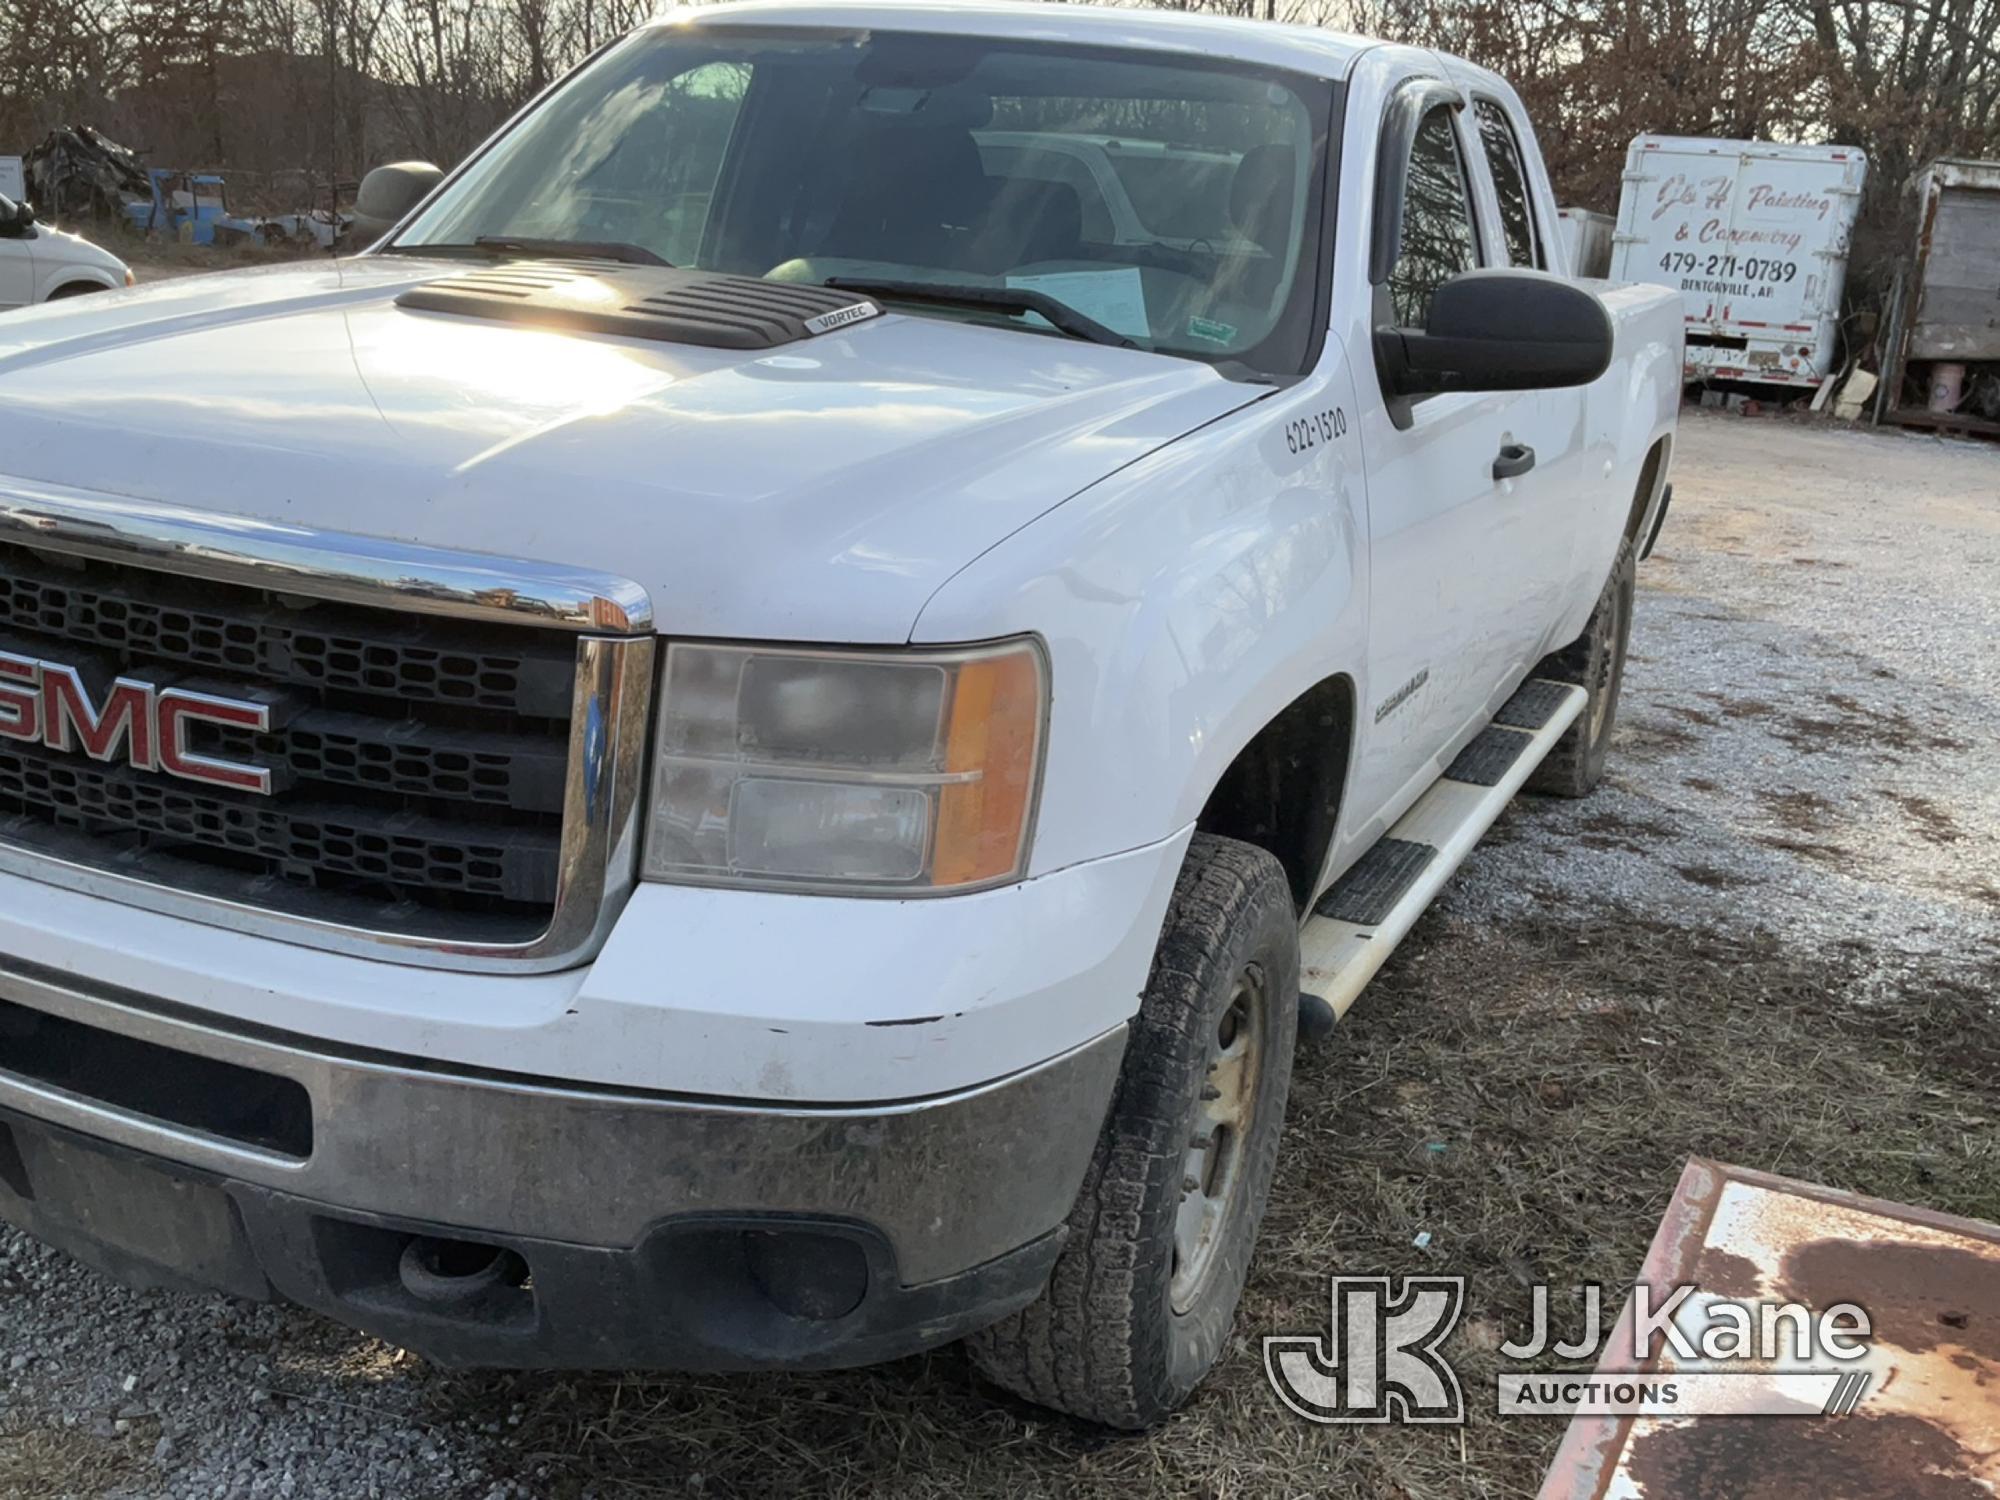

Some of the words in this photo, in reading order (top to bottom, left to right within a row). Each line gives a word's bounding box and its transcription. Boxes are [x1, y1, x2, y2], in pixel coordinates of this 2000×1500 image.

[1747, 184, 1830, 221] Painting
[1674, 221, 1689, 241] &
[1659, 252, 1797, 284] 479-271-0789
[817, 305, 868, 329] VORTEC
[1285, 406, 1347, 455] 622-1520
